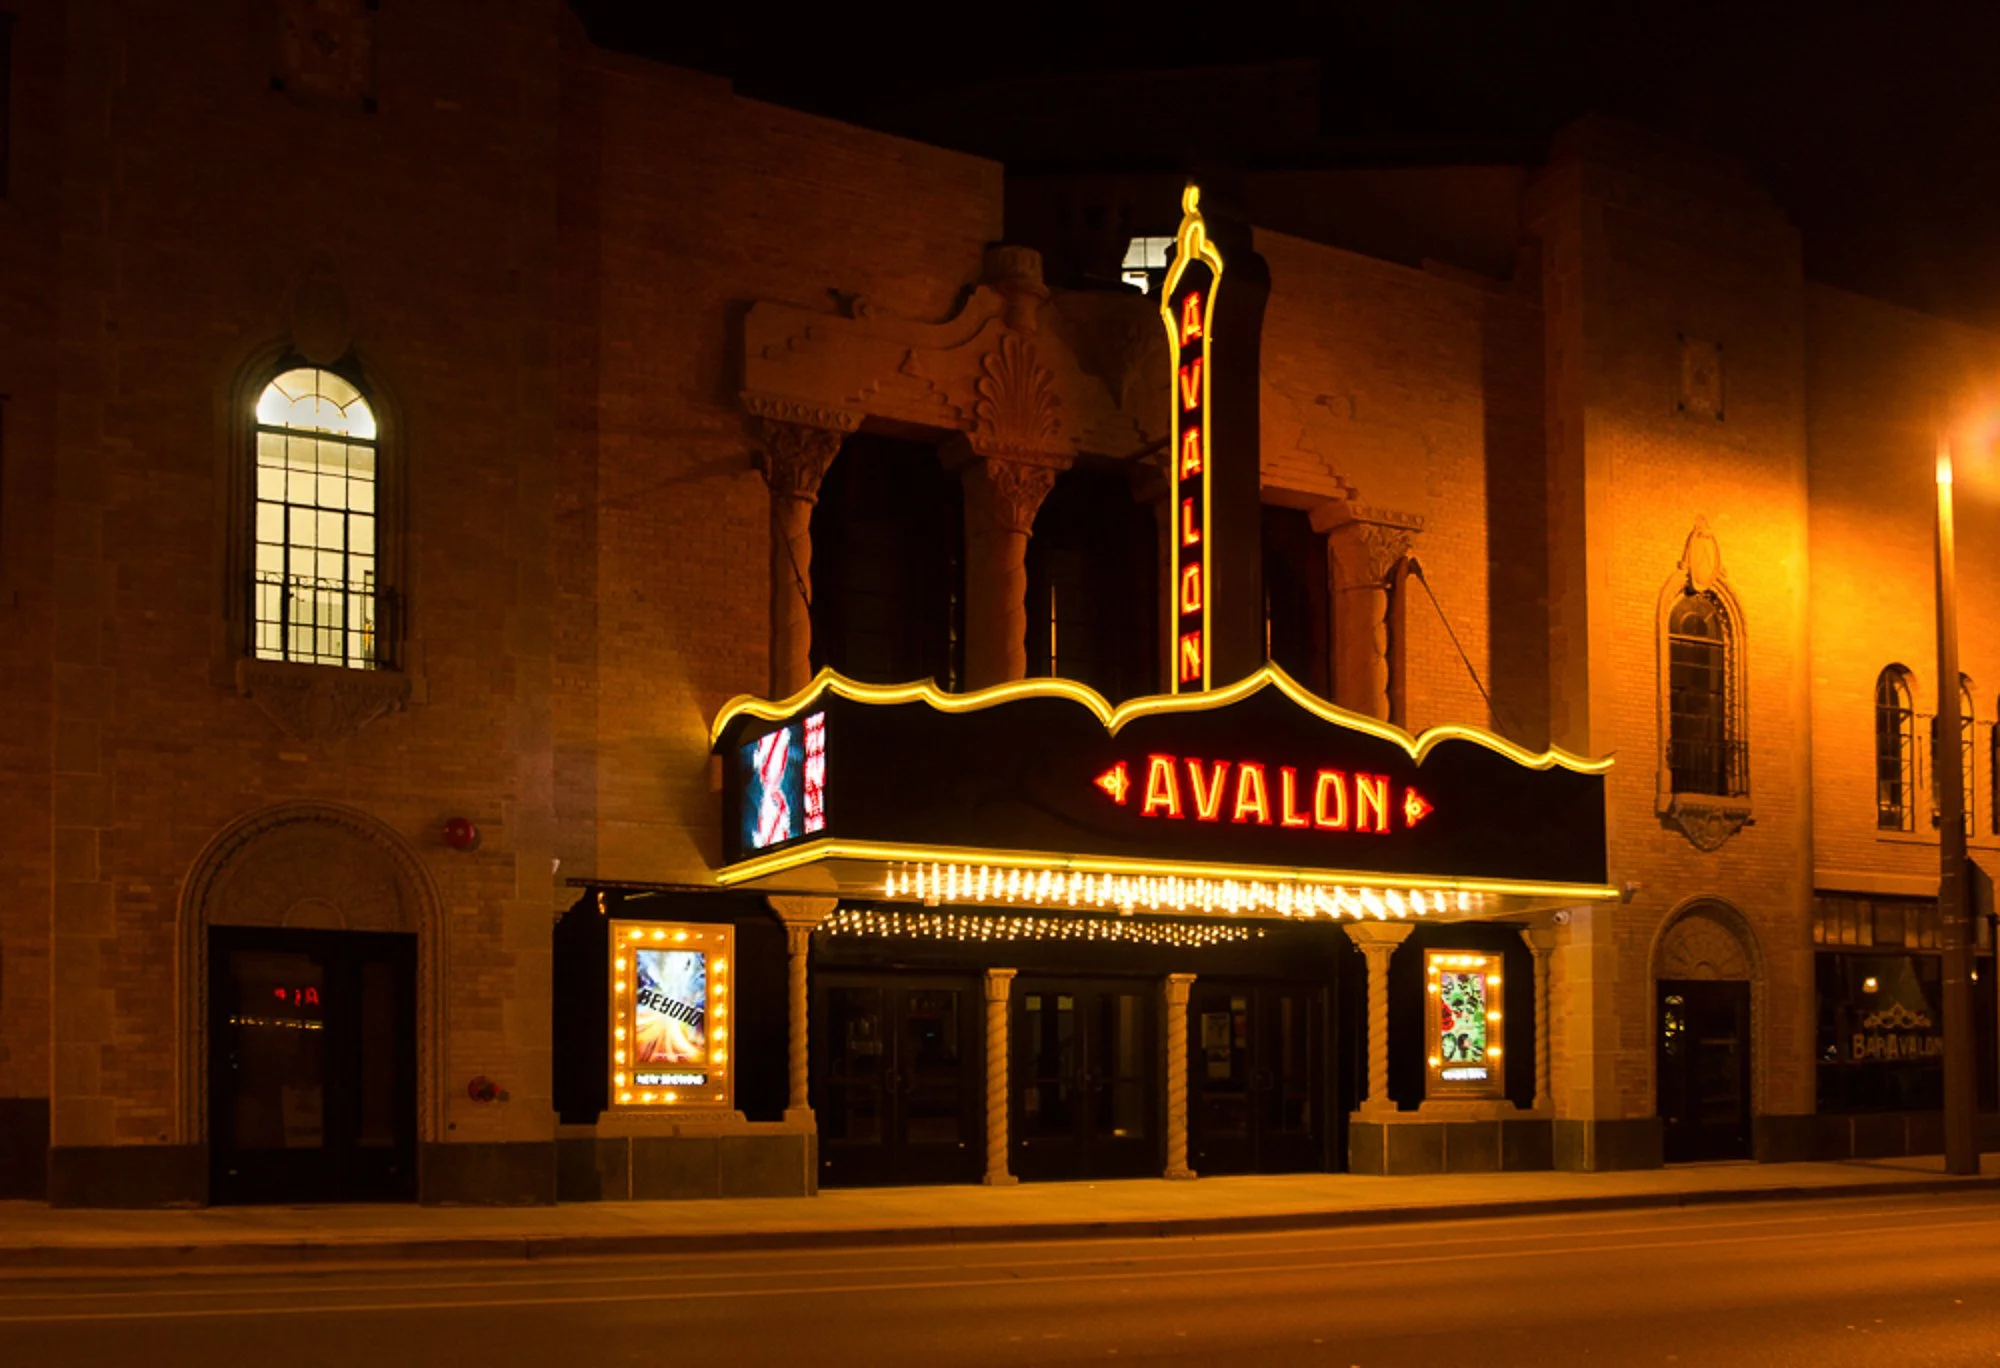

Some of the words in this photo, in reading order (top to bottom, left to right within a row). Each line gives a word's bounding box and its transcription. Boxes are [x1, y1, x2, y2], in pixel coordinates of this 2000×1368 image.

[1179, 291, 1203, 684] AVALON
[1140, 754, 1391, 834] AVALON
[638, 988, 704, 1027] BEYOND
